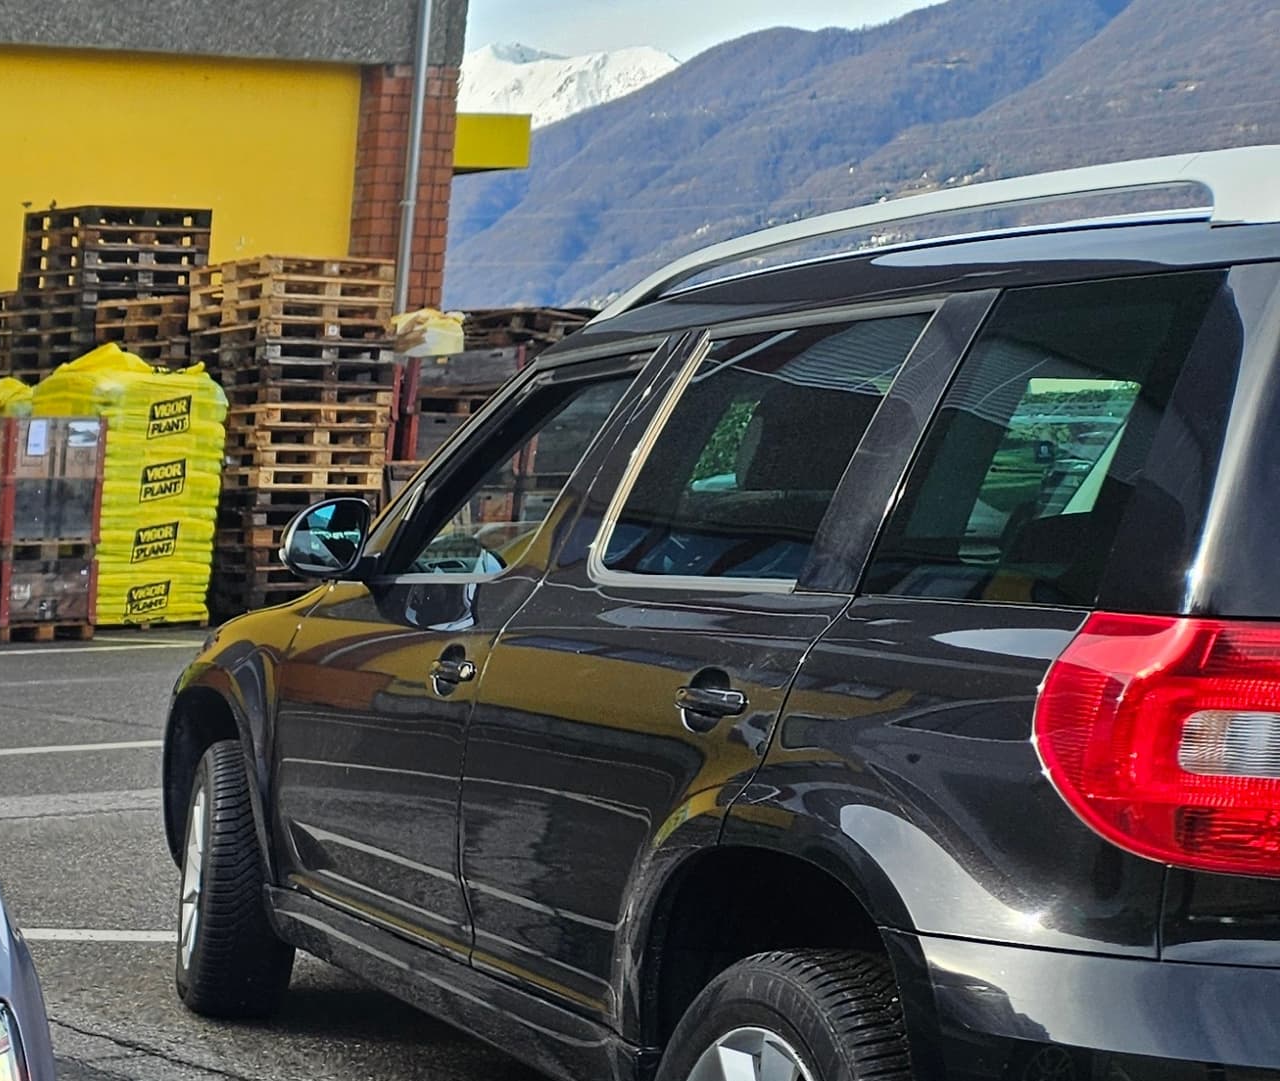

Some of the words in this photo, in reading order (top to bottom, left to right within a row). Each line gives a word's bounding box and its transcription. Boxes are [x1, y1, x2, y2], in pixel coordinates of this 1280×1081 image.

[152, 398, 187, 418] VIGOR
[151, 419, 186, 435] PLANT
[146, 463, 181, 482] VIGOR
[144, 482, 179, 498] PLANT
[139, 526, 173, 543] VIGOR
[136, 543, 172, 559] PLANT
[131, 584, 166, 601] VIGOR
